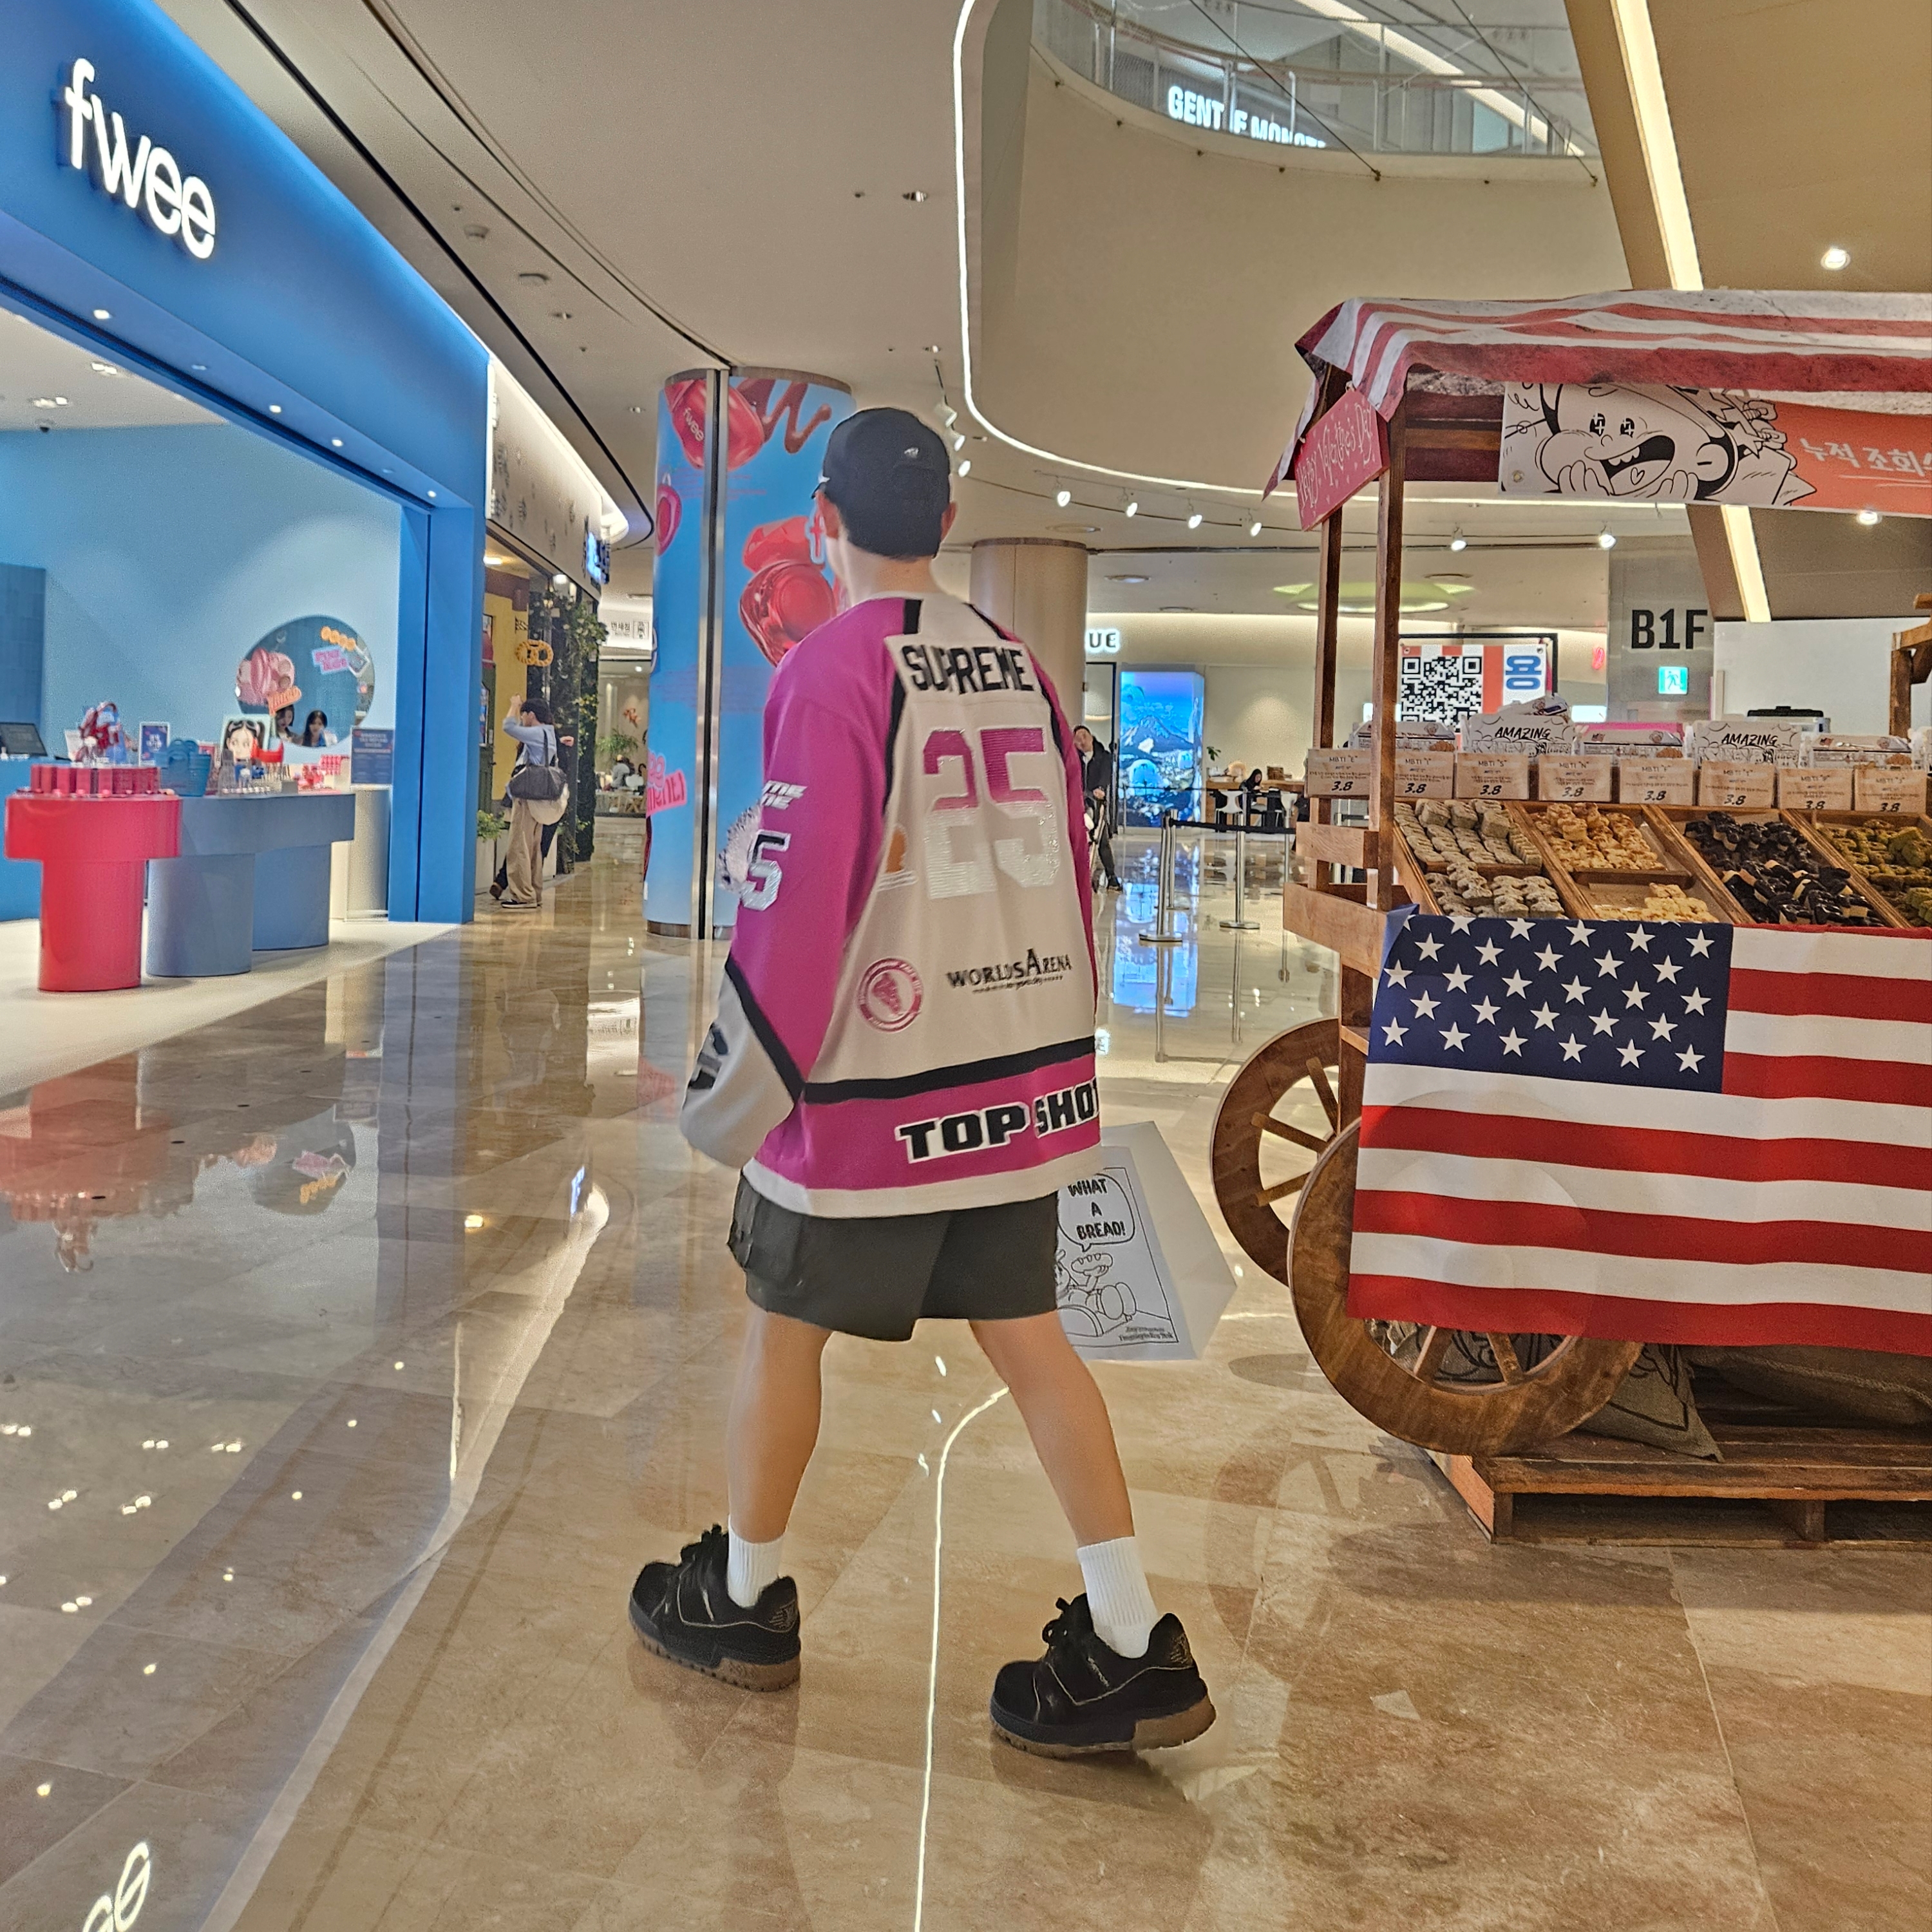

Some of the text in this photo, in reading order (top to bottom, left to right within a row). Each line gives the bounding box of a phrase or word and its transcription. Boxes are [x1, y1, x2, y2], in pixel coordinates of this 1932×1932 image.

[1168, 85, 1248, 135] GENTE
[64, 58, 216, 259] fwee
[683, 407, 705, 442] fwee
[1799, 437, 1861, 469] 누적
[1631, 608, 1709, 650] B1F
[1495, 726, 1552, 740] AMAZING
[1721, 733, 1779, 746] AMAZING
[1331, 781, 1354, 791] 3.8
[1405, 782, 1427, 793] 3.8
[1480, 784, 1502, 795] 3.8
[1562, 786, 1584, 798] 3.8
[1644, 790, 1667, 801] 3.8
[1724, 794, 1747, 806] 3.8
[922, 726, 1060, 900] 25
[896, 1103, 1030, 1163] TOP
[1067, 1178, 1108, 1197] WHAT
[1090, 1201, 1103, 1217] A
[1075, 1220, 1126, 1240] BREAD!
